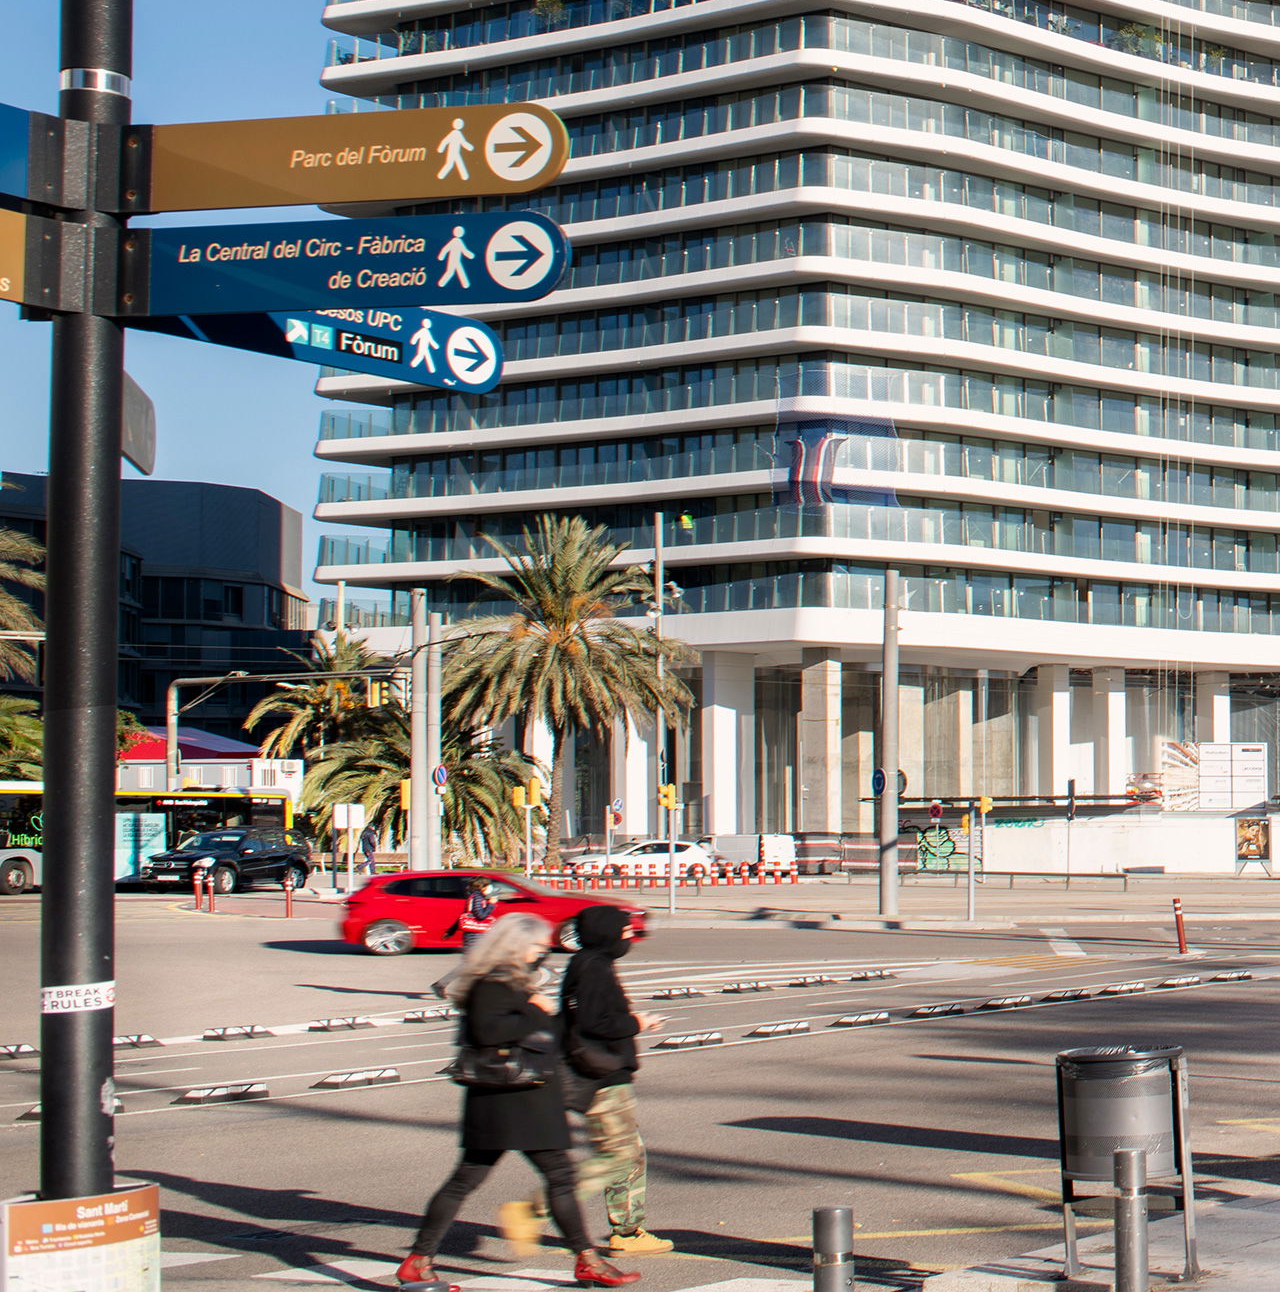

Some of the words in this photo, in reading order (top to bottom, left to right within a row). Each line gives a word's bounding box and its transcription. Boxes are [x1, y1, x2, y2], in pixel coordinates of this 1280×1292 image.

[290, 150, 332, 168] Parc
[336, 147, 363, 166] del
[368, 145, 427, 164] Fòrum
[178, 244, 201, 263] La
[206, 241, 269, 262] Central
[273, 239, 301, 258] del
[305, 238, 341, 257] Circ
[357, 234, 426, 255] Fàbrica
[328, 271, 351, 289] de
[357, 267, 427, 288] Creació
[366, 310, 402, 331] UPC
[315, 329, 330, 344] T4
[340, 332, 398, 361] Fòrum
[51, 997, 102, 1009] RULES
[57, 988, 100, 998] BREAK
[77, 1204, 103, 1219] Sant
[104, 1200, 128, 1215] Martí
